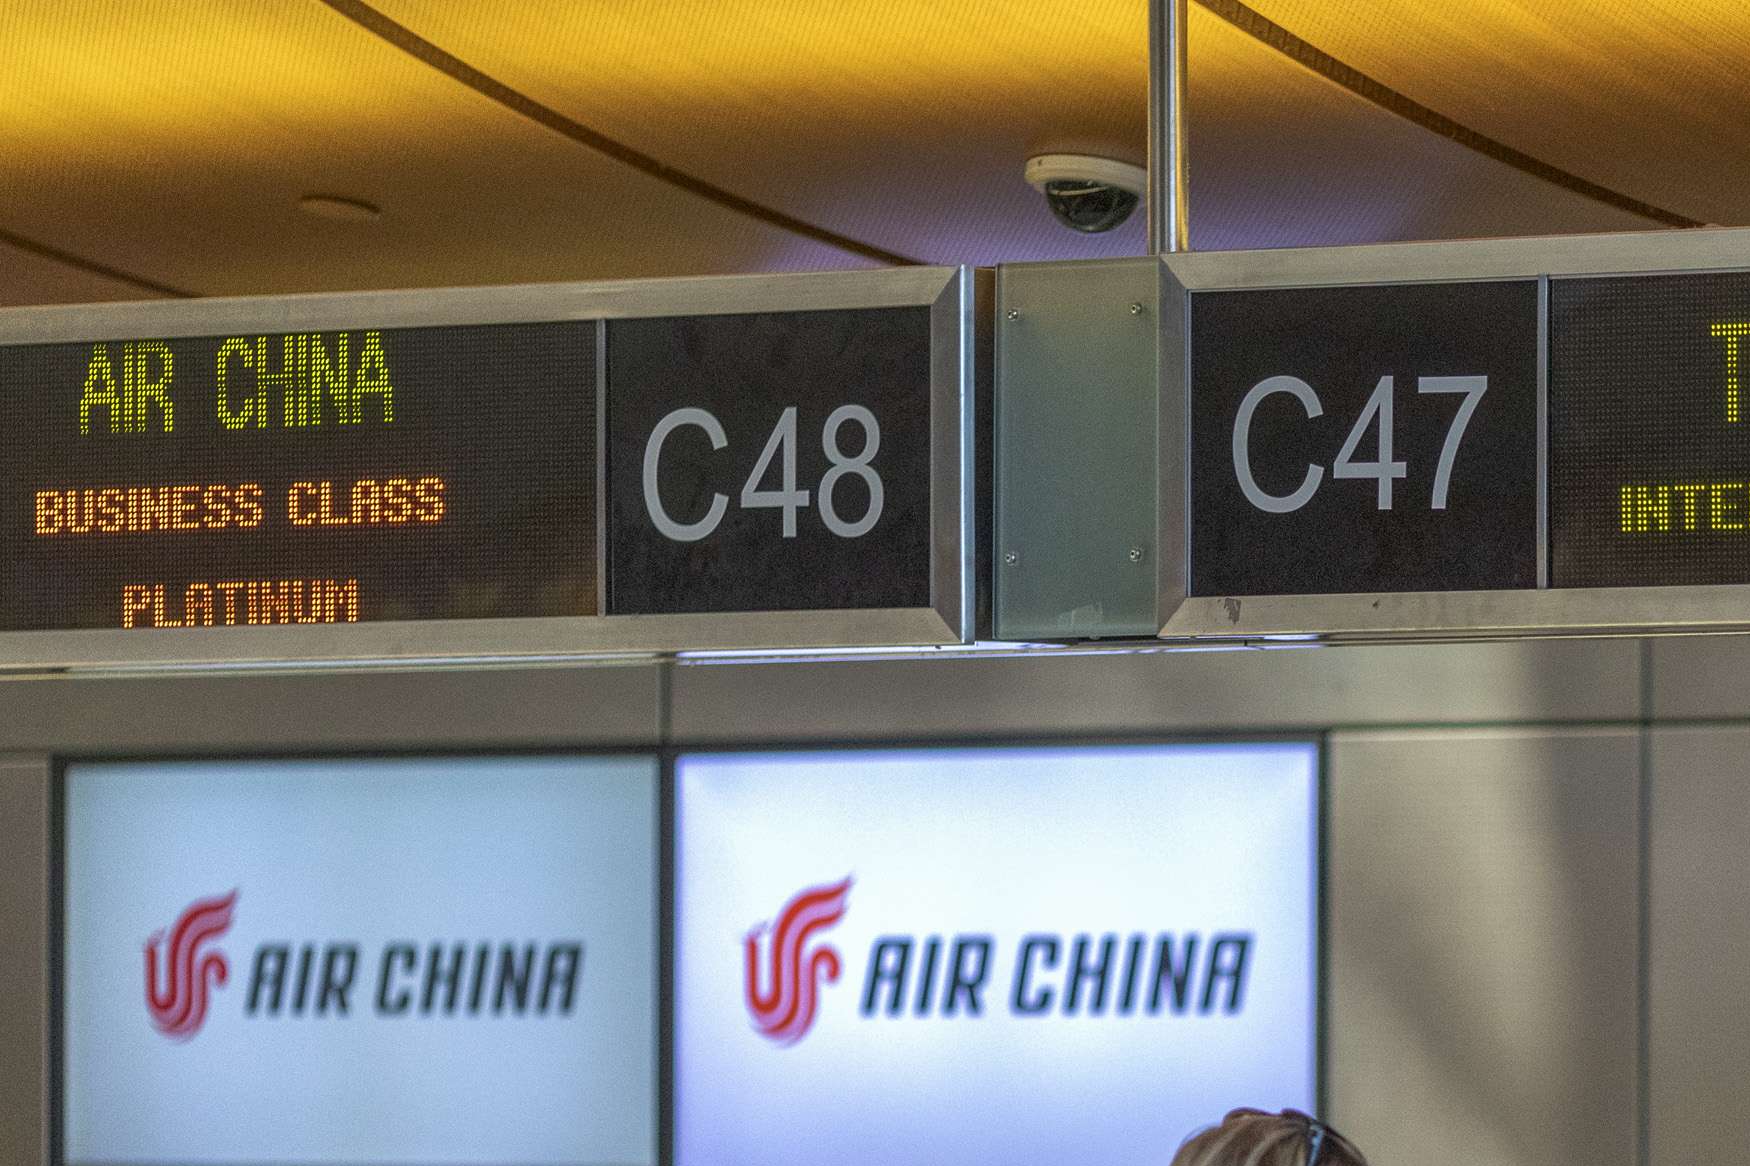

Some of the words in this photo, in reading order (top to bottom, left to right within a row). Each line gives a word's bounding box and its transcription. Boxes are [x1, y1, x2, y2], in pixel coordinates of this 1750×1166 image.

[80, 342, 175, 435] AIR
[216, 331, 395, 431] CHINA
[641, 403, 886, 543] C48
[1231, 374, 1489, 515] C47
[35, 484, 265, 536] BUSINESS
[287, 476, 446, 527] CLASS
[122, 578, 359, 629] PLATINUM
[245, 942, 361, 1017] AIR
[374, 940, 588, 1017] CHINA
[860, 933, 992, 1017] AIR
[1008, 932, 1257, 1017] CHINA
